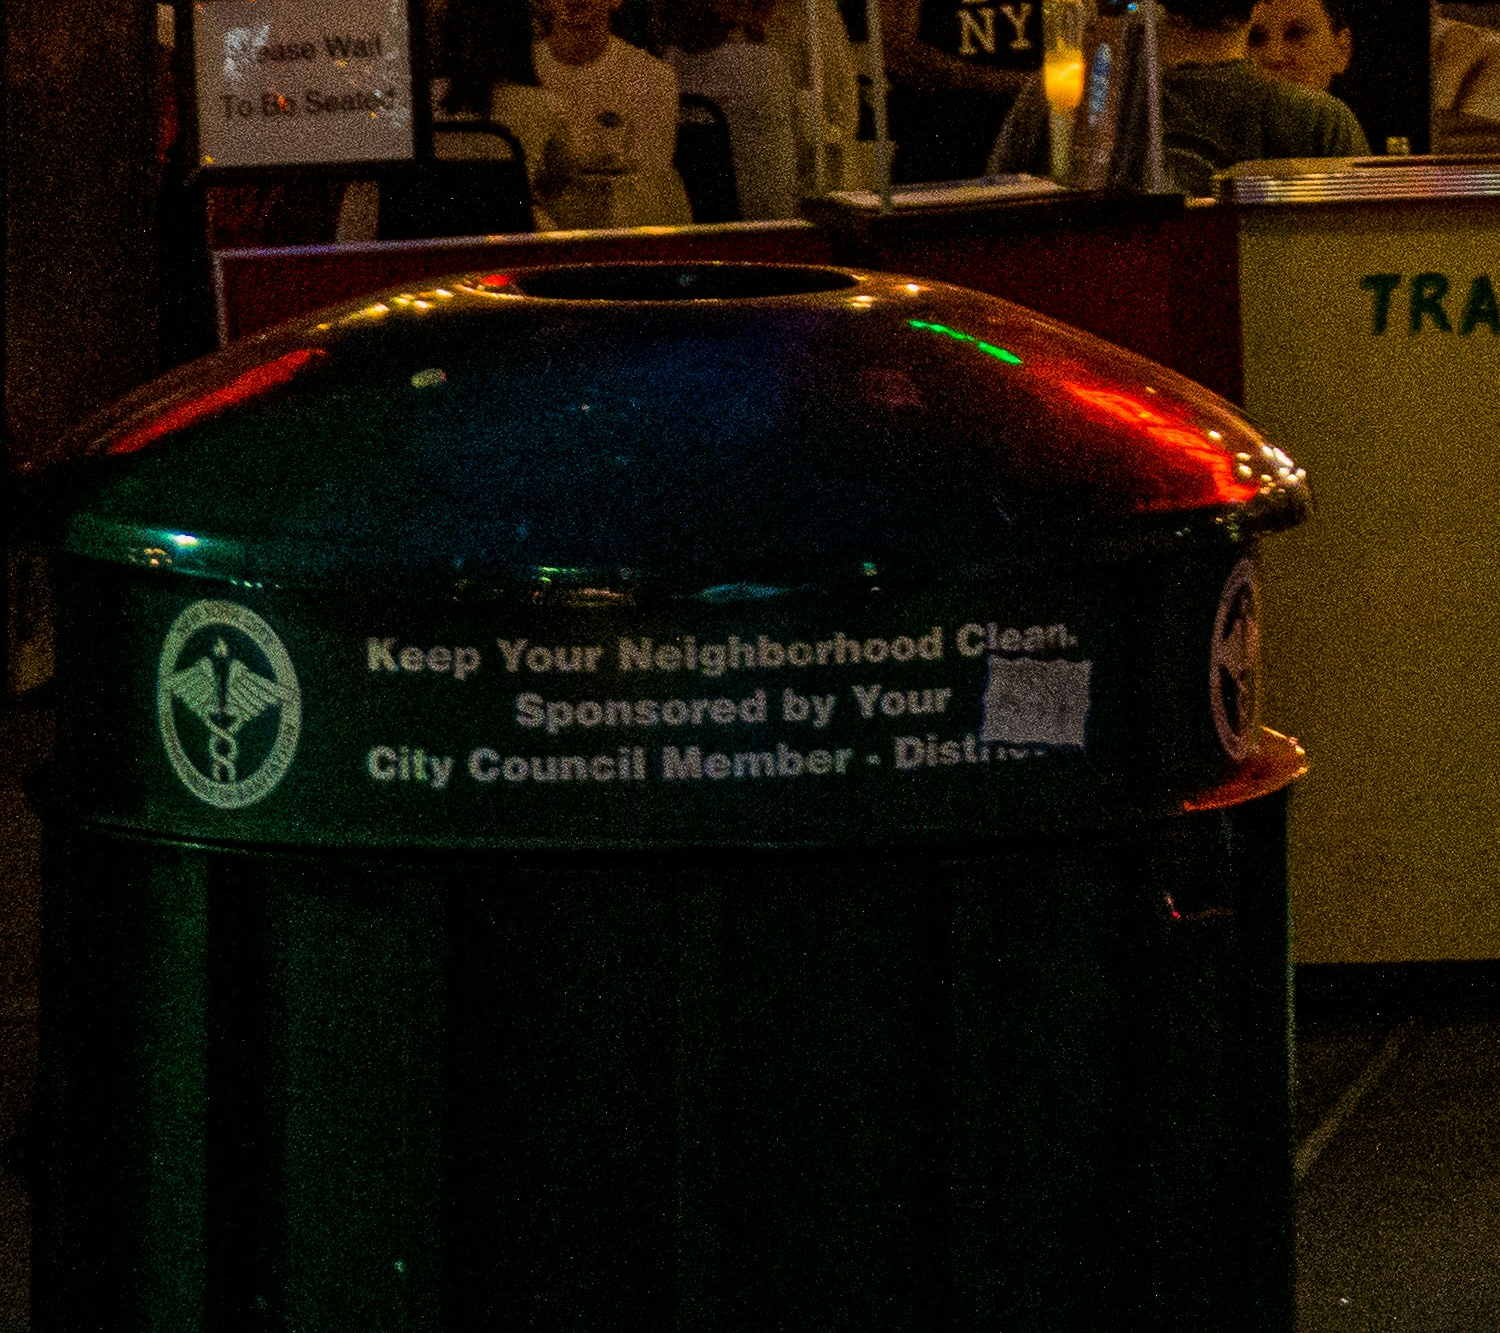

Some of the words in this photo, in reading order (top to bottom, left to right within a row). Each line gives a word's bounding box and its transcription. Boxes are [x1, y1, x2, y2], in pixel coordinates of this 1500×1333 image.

[958, 4, 1032, 56] NY
[221, 94, 255, 120] To
[366, 636, 482, 680] Keep
[497, 636, 603, 673] Your
[618, 626, 944, 679] Neighborhood
[956, 619, 1080, 659] Clean.
[514, 688, 768, 732] Sponsored
[782, 688, 836, 727] by
[851, 684, 953, 720] Your
[366, 746, 455, 788] City
[468, 742, 647, 783] Council
[662, 742, 852, 783] Member
[893, 733, 1048, 771] Dist
